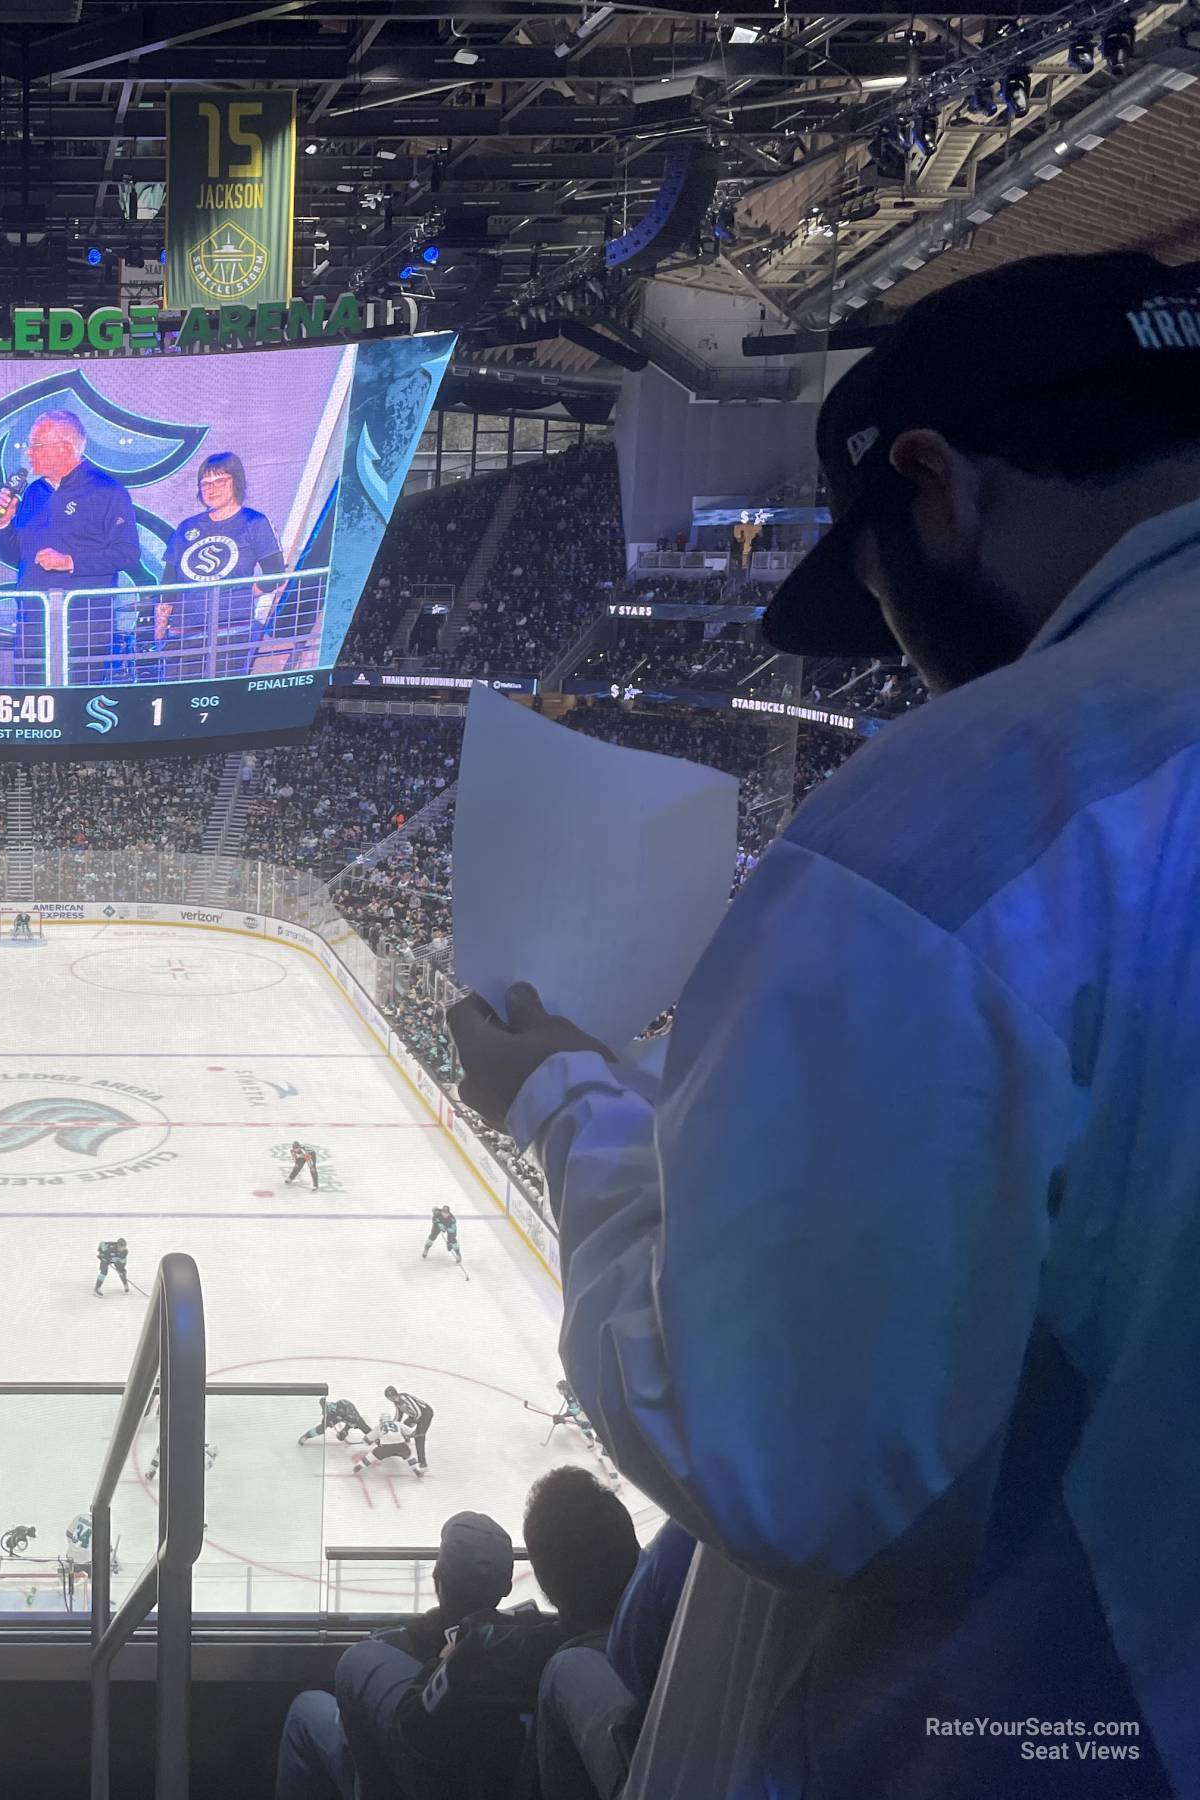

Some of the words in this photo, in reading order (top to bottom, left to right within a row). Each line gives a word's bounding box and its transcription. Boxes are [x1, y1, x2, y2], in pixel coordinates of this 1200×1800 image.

[199, 102, 263, 178] 15
[196, 183, 265, 209] JACKSON
[192, 255, 231, 294] SEATTLE
[237, 254, 265, 292] STORM
[175, 292, 362, 348] ARENA
[1126, 309, 1200, 349] KRA
[618, 605, 652, 616] STARS
[248, 674, 314, 691] PENALTIES
[151, 698, 163, 726] 1
[191, 696, 220, 708] SOG
[731, 698, 784, 713] STARBUCKS
[787, 705, 828, 723] COMMUNITY
[830, 714, 853, 729] STARS
[200, 713, 208, 724] 7
[15, 729, 62, 739] PERIOD
[180, 911, 219, 924] verizon
[91, 1079, 165, 1101] ARENA
[75, 1150, 179, 1182] CLIMATE
